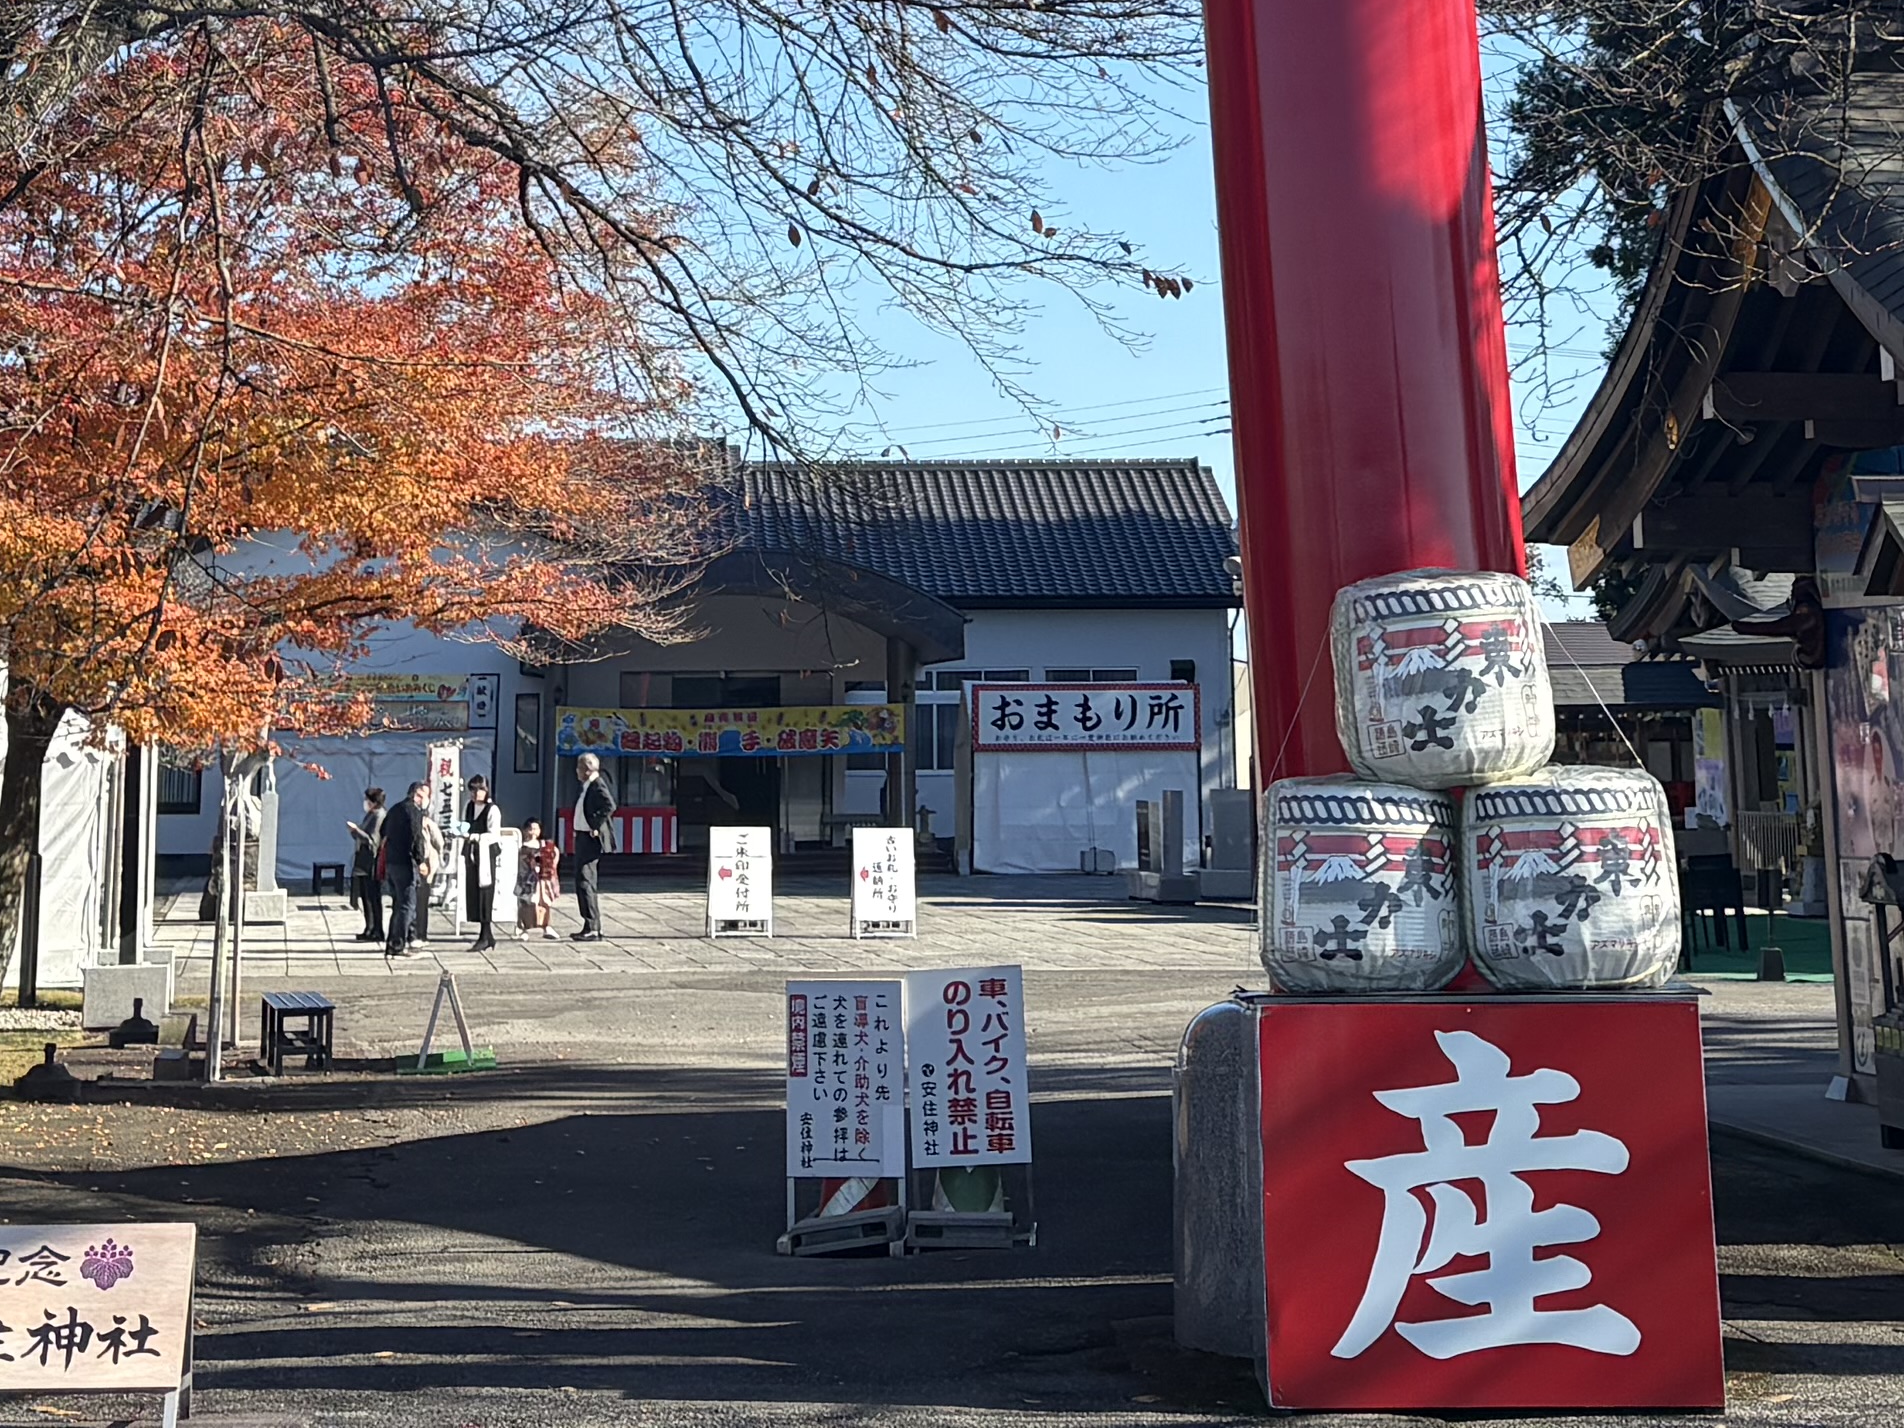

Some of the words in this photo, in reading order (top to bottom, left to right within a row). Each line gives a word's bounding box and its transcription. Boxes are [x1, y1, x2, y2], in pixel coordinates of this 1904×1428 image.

[990, 693, 1185, 733] おまもり所
[811, 994, 828, 1101] ご遠慮下さい
[852, 994, 871, 1161] 盲導犬・介助犬を除く
[873, 994, 891, 1101] これより先
[942, 980, 979, 1155] のり入れ禁止
[978, 978, 1015, 1154] 車、バイク、自転車
[799, 1111, 813, 1169] 安住神社
[921, 1081, 940, 1156] 安住神社
[1330, 1030, 1643, 1360] 産
